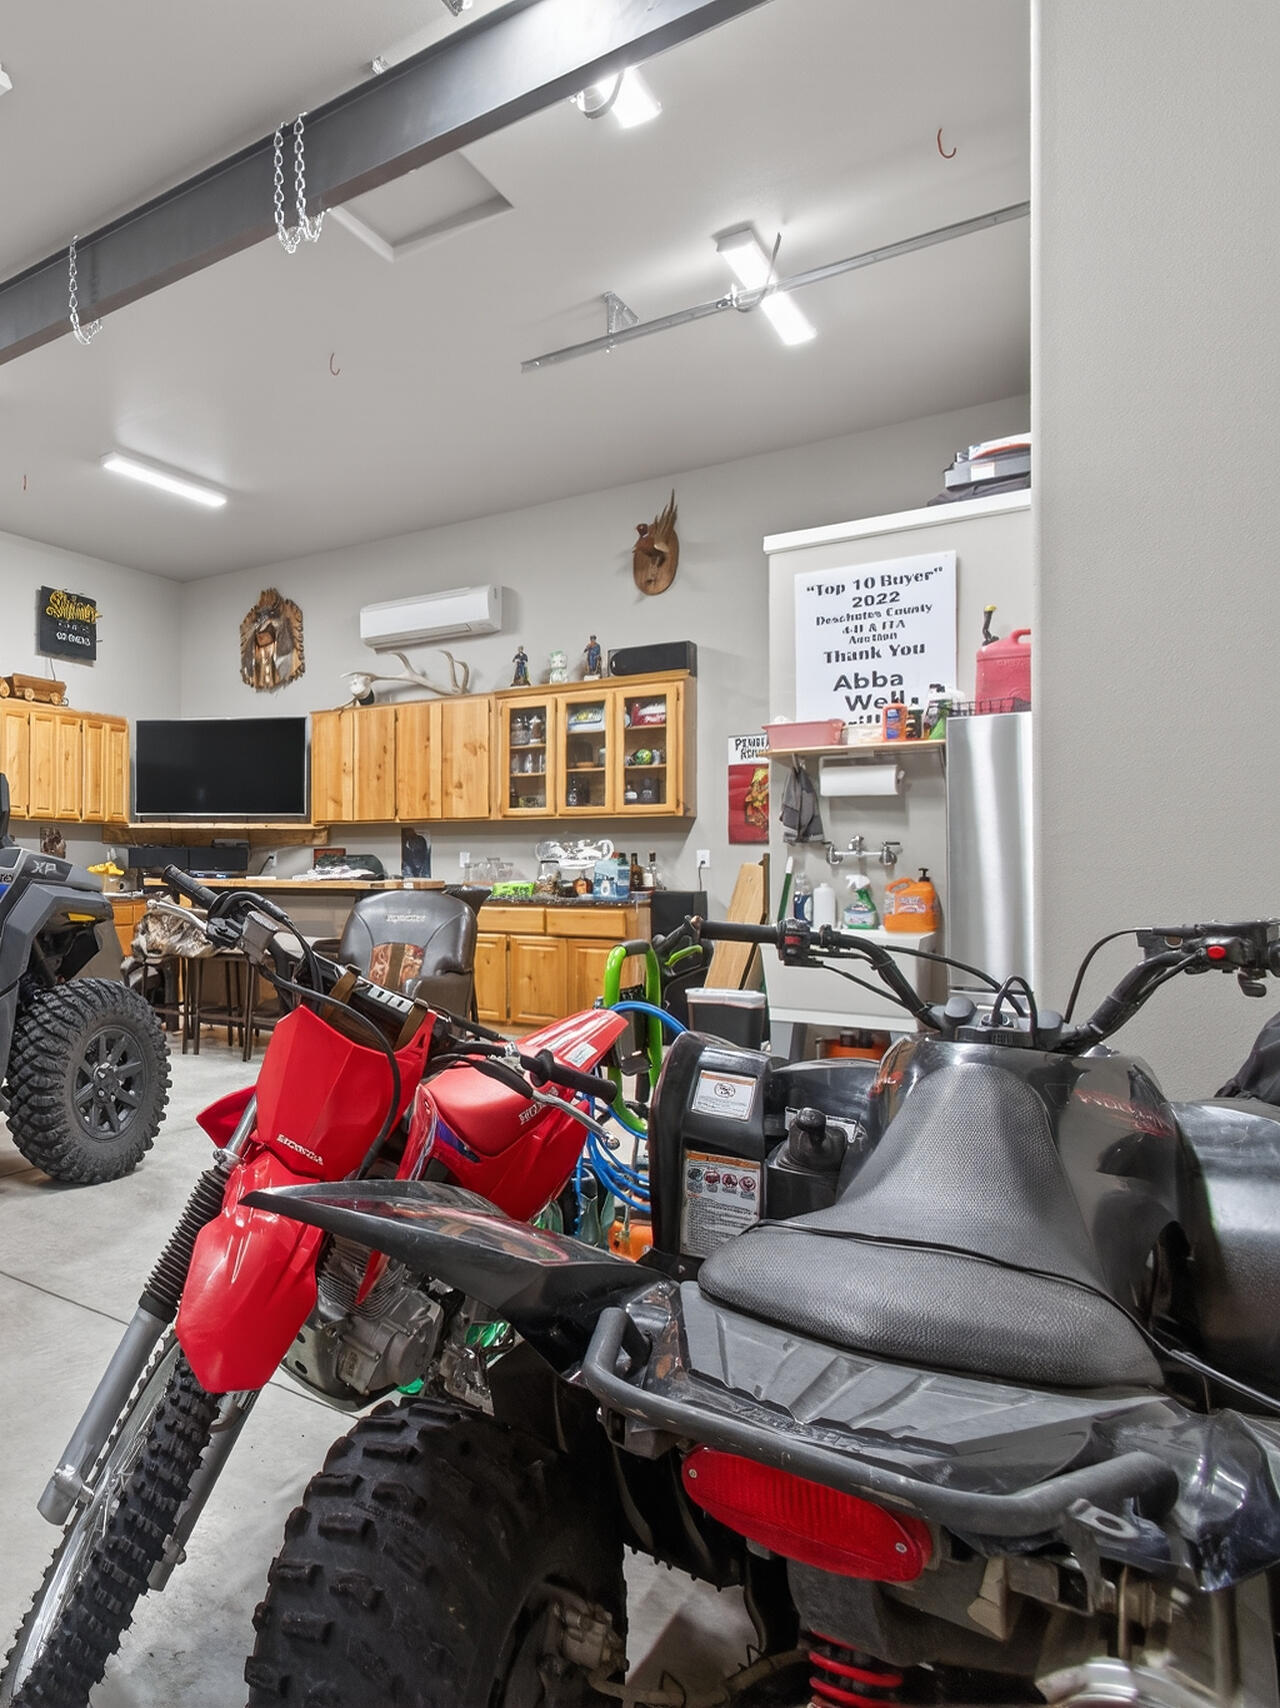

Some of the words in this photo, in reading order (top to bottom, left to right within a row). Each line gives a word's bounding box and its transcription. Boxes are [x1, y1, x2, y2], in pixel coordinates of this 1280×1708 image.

[852, 577, 876, 590] 10
[851, 590, 901, 609] 2022
[815, 611, 882, 627] Deschutes
[886, 604, 933, 617] County
[824, 646, 882, 664] Thank
[889, 643, 926, 657] You
[833, 670, 904, 692] Abba
[31, 860, 58, 875] XP
